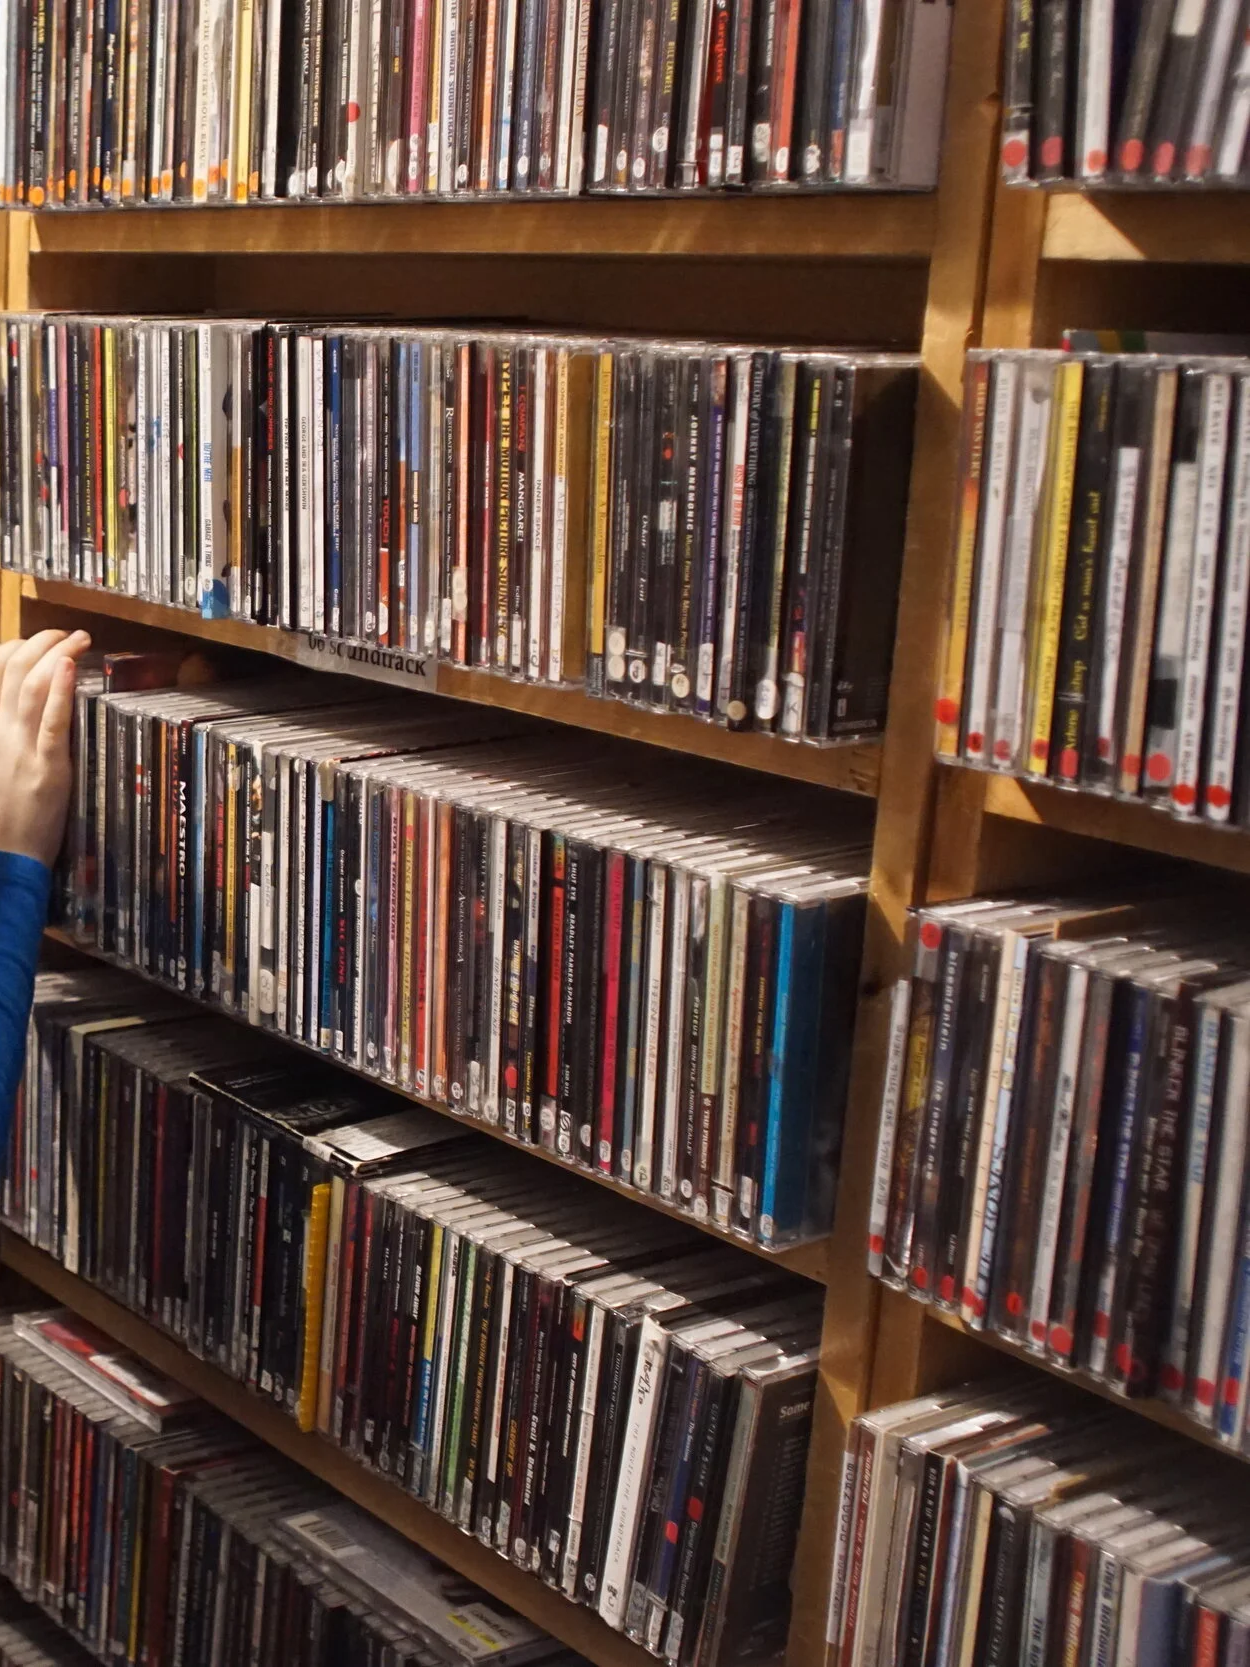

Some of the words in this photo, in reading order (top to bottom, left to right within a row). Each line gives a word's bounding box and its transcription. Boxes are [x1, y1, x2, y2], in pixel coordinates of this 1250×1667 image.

[666, 41, 675, 59] BILL
[200, 44, 209, 98] COUNTRY
[464, 57, 472, 90] ANGELO
[576, 46, 588, 116] SEDUCTION
[663, 60, 674, 94] LASWELL
[199, 101, 207, 131] SOUL
[446, 81, 454, 146] SOUNDTRACK
[267, 371, 273, 383] OF
[750, 370, 762, 408] THEORY
[974, 382, 985, 416] BIRD
[996, 377, 1009, 415] BIRDS
[445, 407, 454, 463] RESTORATION
[501, 418, 510, 443] THE
[688, 414, 698, 461] JOHNNY
[994, 420, 1006, 434] OF
[747, 422, 760, 485] EVERYTHING
[970, 421, 982, 478] SISTERS
[500, 446, 510, 499] MOTION
[734, 463, 744, 482] KISS
[686, 466, 696, 530] MNEMONIC
[732, 499, 742, 526] DEATH
[499, 506, 510, 560] PICTURE
[640, 514, 648, 547] Oskar
[405, 889, 412, 902] IT
[457, 891, 466, 922] ANGELS
[402, 951, 410, 994] HOME
[511, 938, 521, 974] HUNTING
[565, 951, 574, 1024] PARKER-SPARROW
[939, 950, 958, 1051] bloemfontein
[490, 977, 500, 1036] NUTCRACKER
[691, 995, 700, 1036] PROTEUS
[1166, 1026, 1189, 1101] BLINKER
[1202, 1023, 1218, 1091] BLINKER
[687, 1088, 695, 1121] ANDREW
[934, 1079, 944, 1101] the
[701, 1109, 709, 1128] THE
[928, 1106, 941, 1149] longer
[1159, 1111, 1177, 1140] THE
[1196, 1105, 1210, 1129] THE
[685, 1122, 693, 1156] ZEALLEY
[699, 1129, 708, 1170] PRESENT
[925, 1154, 936, 1180] now
[1152, 1146, 1171, 1192] STAR
[1190, 1141, 1205, 1182] STAR
[382, 1247, 390, 1279] BLADE
[413, 1264, 422, 1295] BLOWN
[411, 1294, 419, 1320] AWAY
[480, 1318, 489, 1332] THE
[477, 1332, 488, 1365] BROTHER
[475, 1367, 484, 1386] FROM
[569, 1368, 576, 1379] OF
[612, 1352, 621, 1390] CHILDREN
[422, 1389, 429, 1400] IN
[472, 1386, 482, 1420] ANOTHER
[566, 1378, 575, 1413] INDUSTRY
[610, 1391, 616, 1401] OF
[470, 1421, 480, 1448] PLANET
[506, 1418, 518, 1461] CAUGHT
[529, 1414, 539, 1441] Cecil
[562, 1413, 572, 1457] SOUNDTRACK
[682, 1433, 692, 1462] Sessions
[504, 1461, 514, 1477] UP
[522, 1455, 534, 1506] DeMented
[614, 1505, 626, 1562] SOUNDTRACK
[687, 1521, 697, 1547] Original
[679, 1573, 689, 1596] Picture
[1102, 1561, 1118, 1599] Chris
[1031, 1617, 1044, 1641] THE
